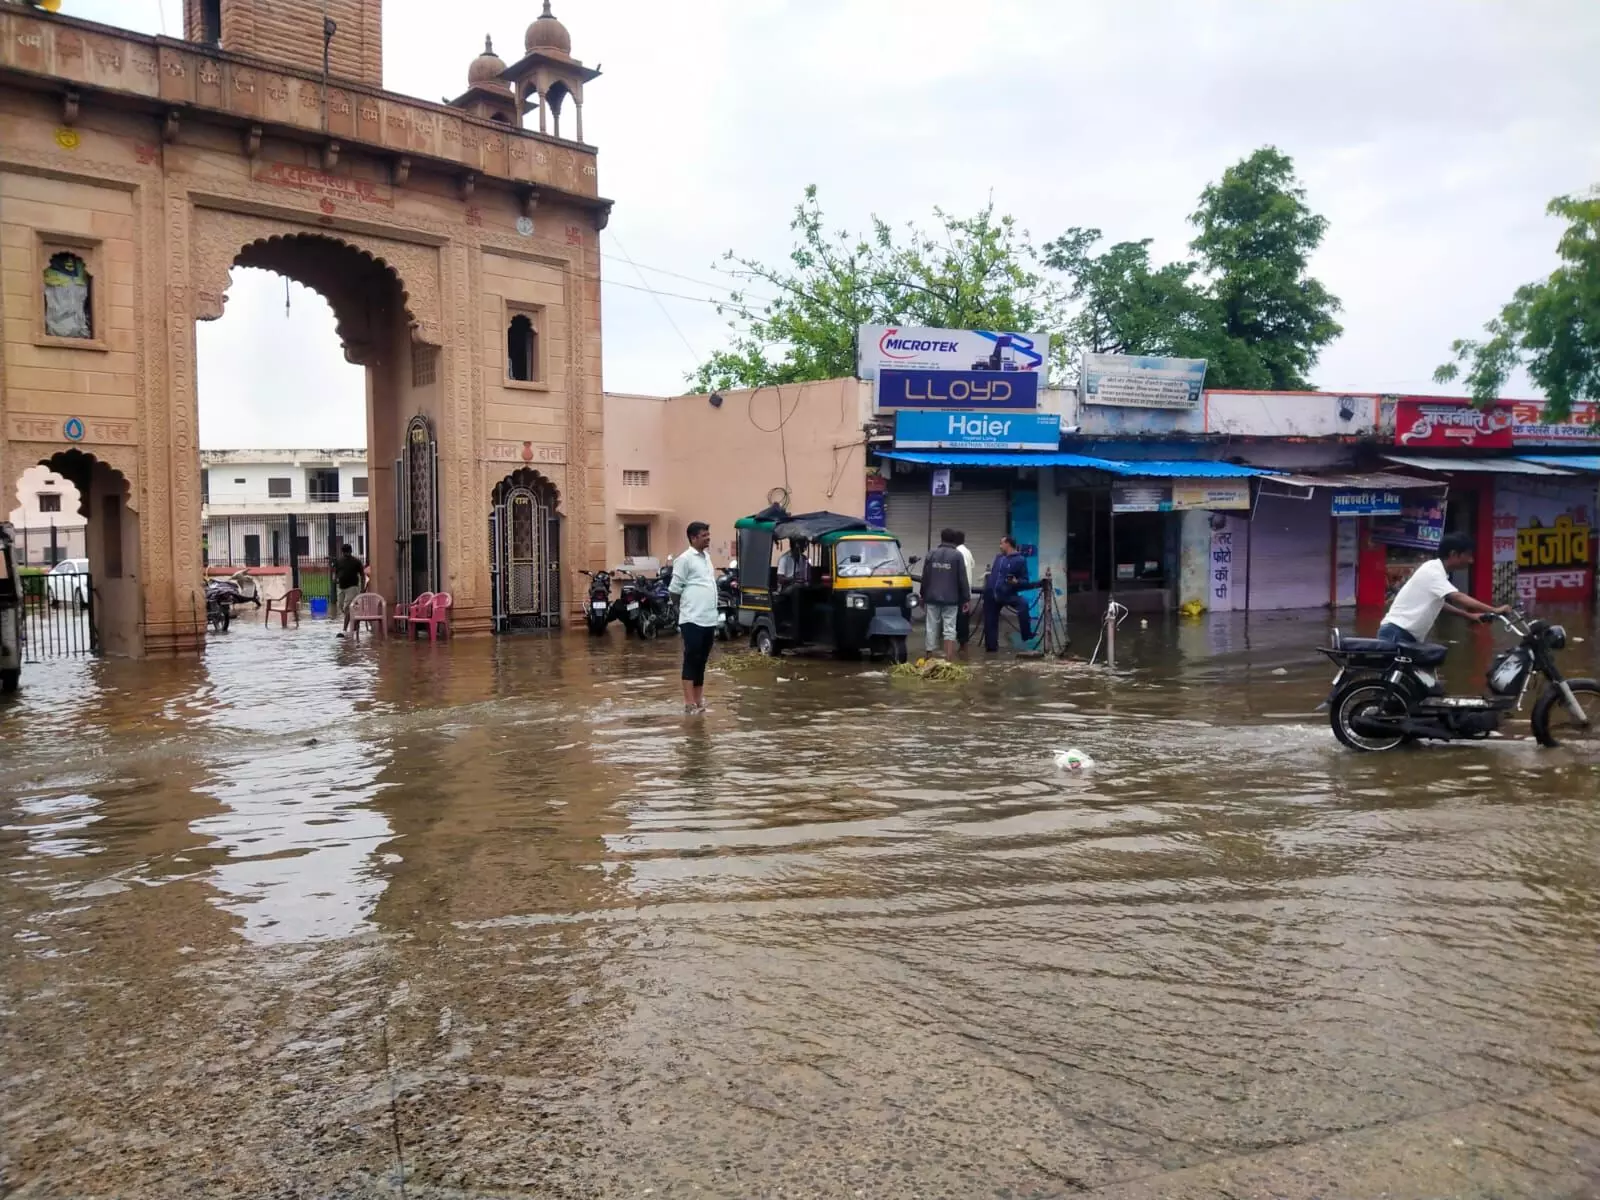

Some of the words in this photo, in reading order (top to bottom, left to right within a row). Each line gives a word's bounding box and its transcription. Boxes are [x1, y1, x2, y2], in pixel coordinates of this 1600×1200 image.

[886, 338, 959, 353] MICROTEK
[904, 378, 1012, 401] LLOYD
[947, 414, 1011, 437] Haier
[1517, 514, 1590, 567] संजीव
[1213, 547, 1232, 564] फोटो
[1214, 584, 1228, 600] पी
